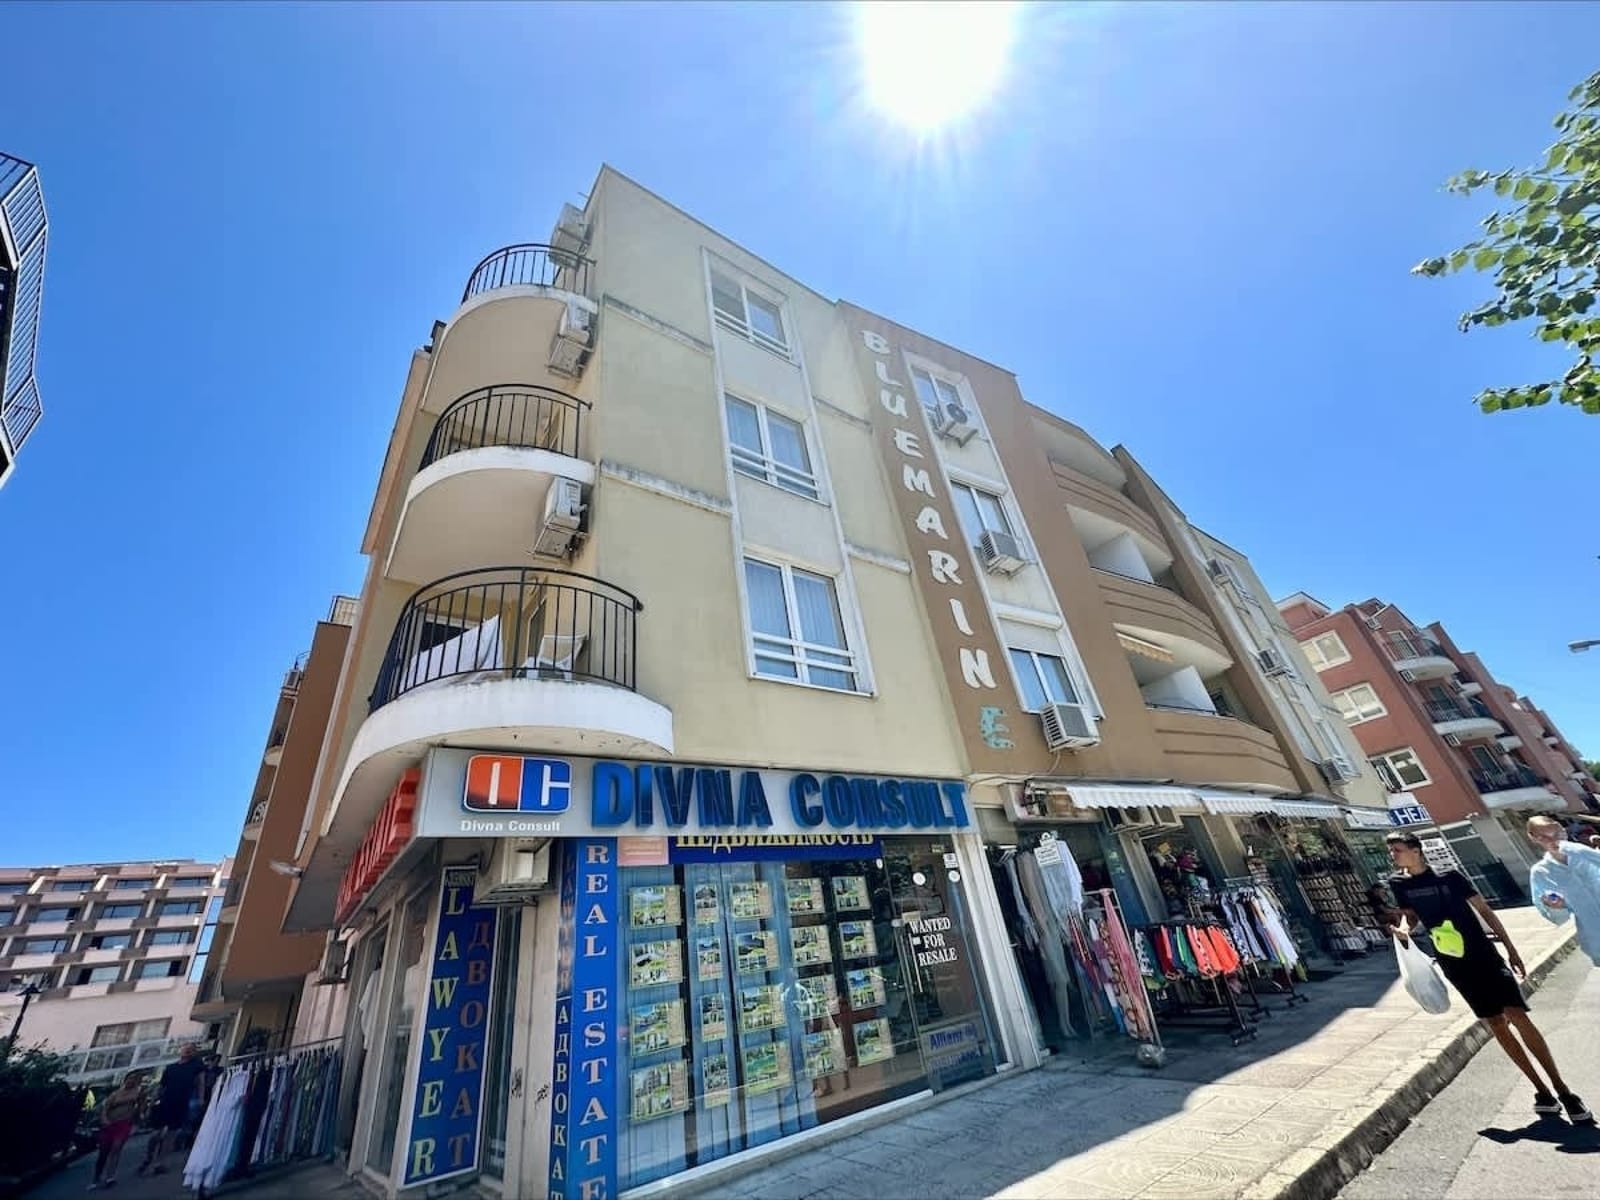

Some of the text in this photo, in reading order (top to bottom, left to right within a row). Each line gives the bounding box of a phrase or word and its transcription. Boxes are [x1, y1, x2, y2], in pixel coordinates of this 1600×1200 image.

[591, 760, 971, 829] DIVNA CONSULT
[460, 819, 561, 833] Divna Consult
[909, 916, 951, 934] WANTED
[923, 933, 946, 949] FOR
[917, 947, 958, 967] RESALE
[409, 887, 465, 1179] LAWYER
[448, 921, 491, 1167] ДВОКАТ
[579, 844, 610, 1200] REAL ESTATE
